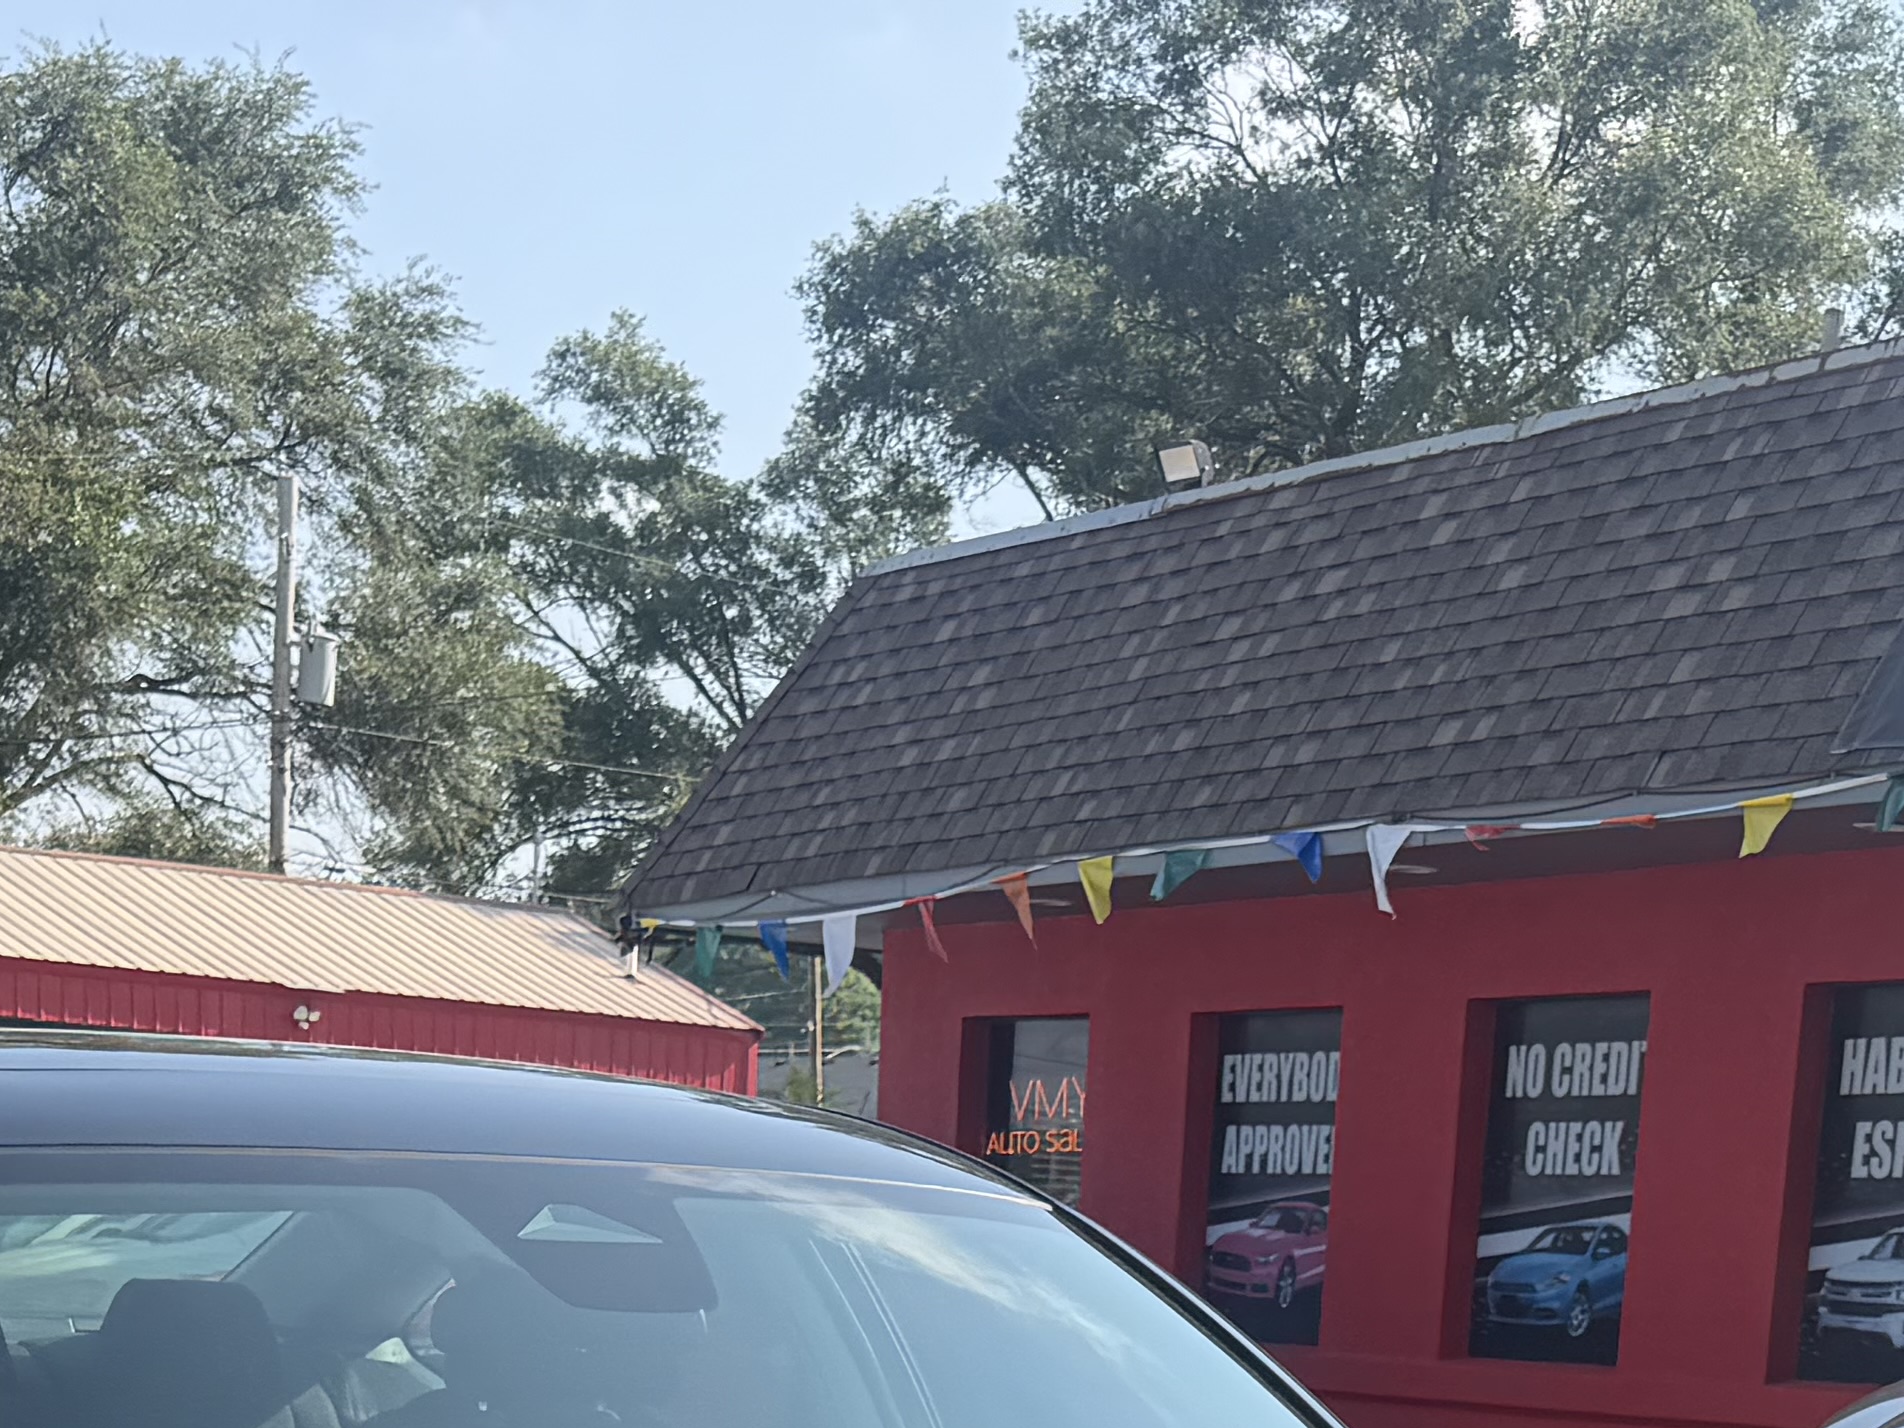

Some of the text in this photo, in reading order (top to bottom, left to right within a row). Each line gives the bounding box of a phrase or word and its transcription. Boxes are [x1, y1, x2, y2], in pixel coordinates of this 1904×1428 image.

[1504, 1040, 1648, 1099] NO CREDI
[985, 1130, 1042, 1156] AUTO
[1220, 1124, 1336, 1176] APPROVE
[1524, 1119, 1625, 1177] CHECK
